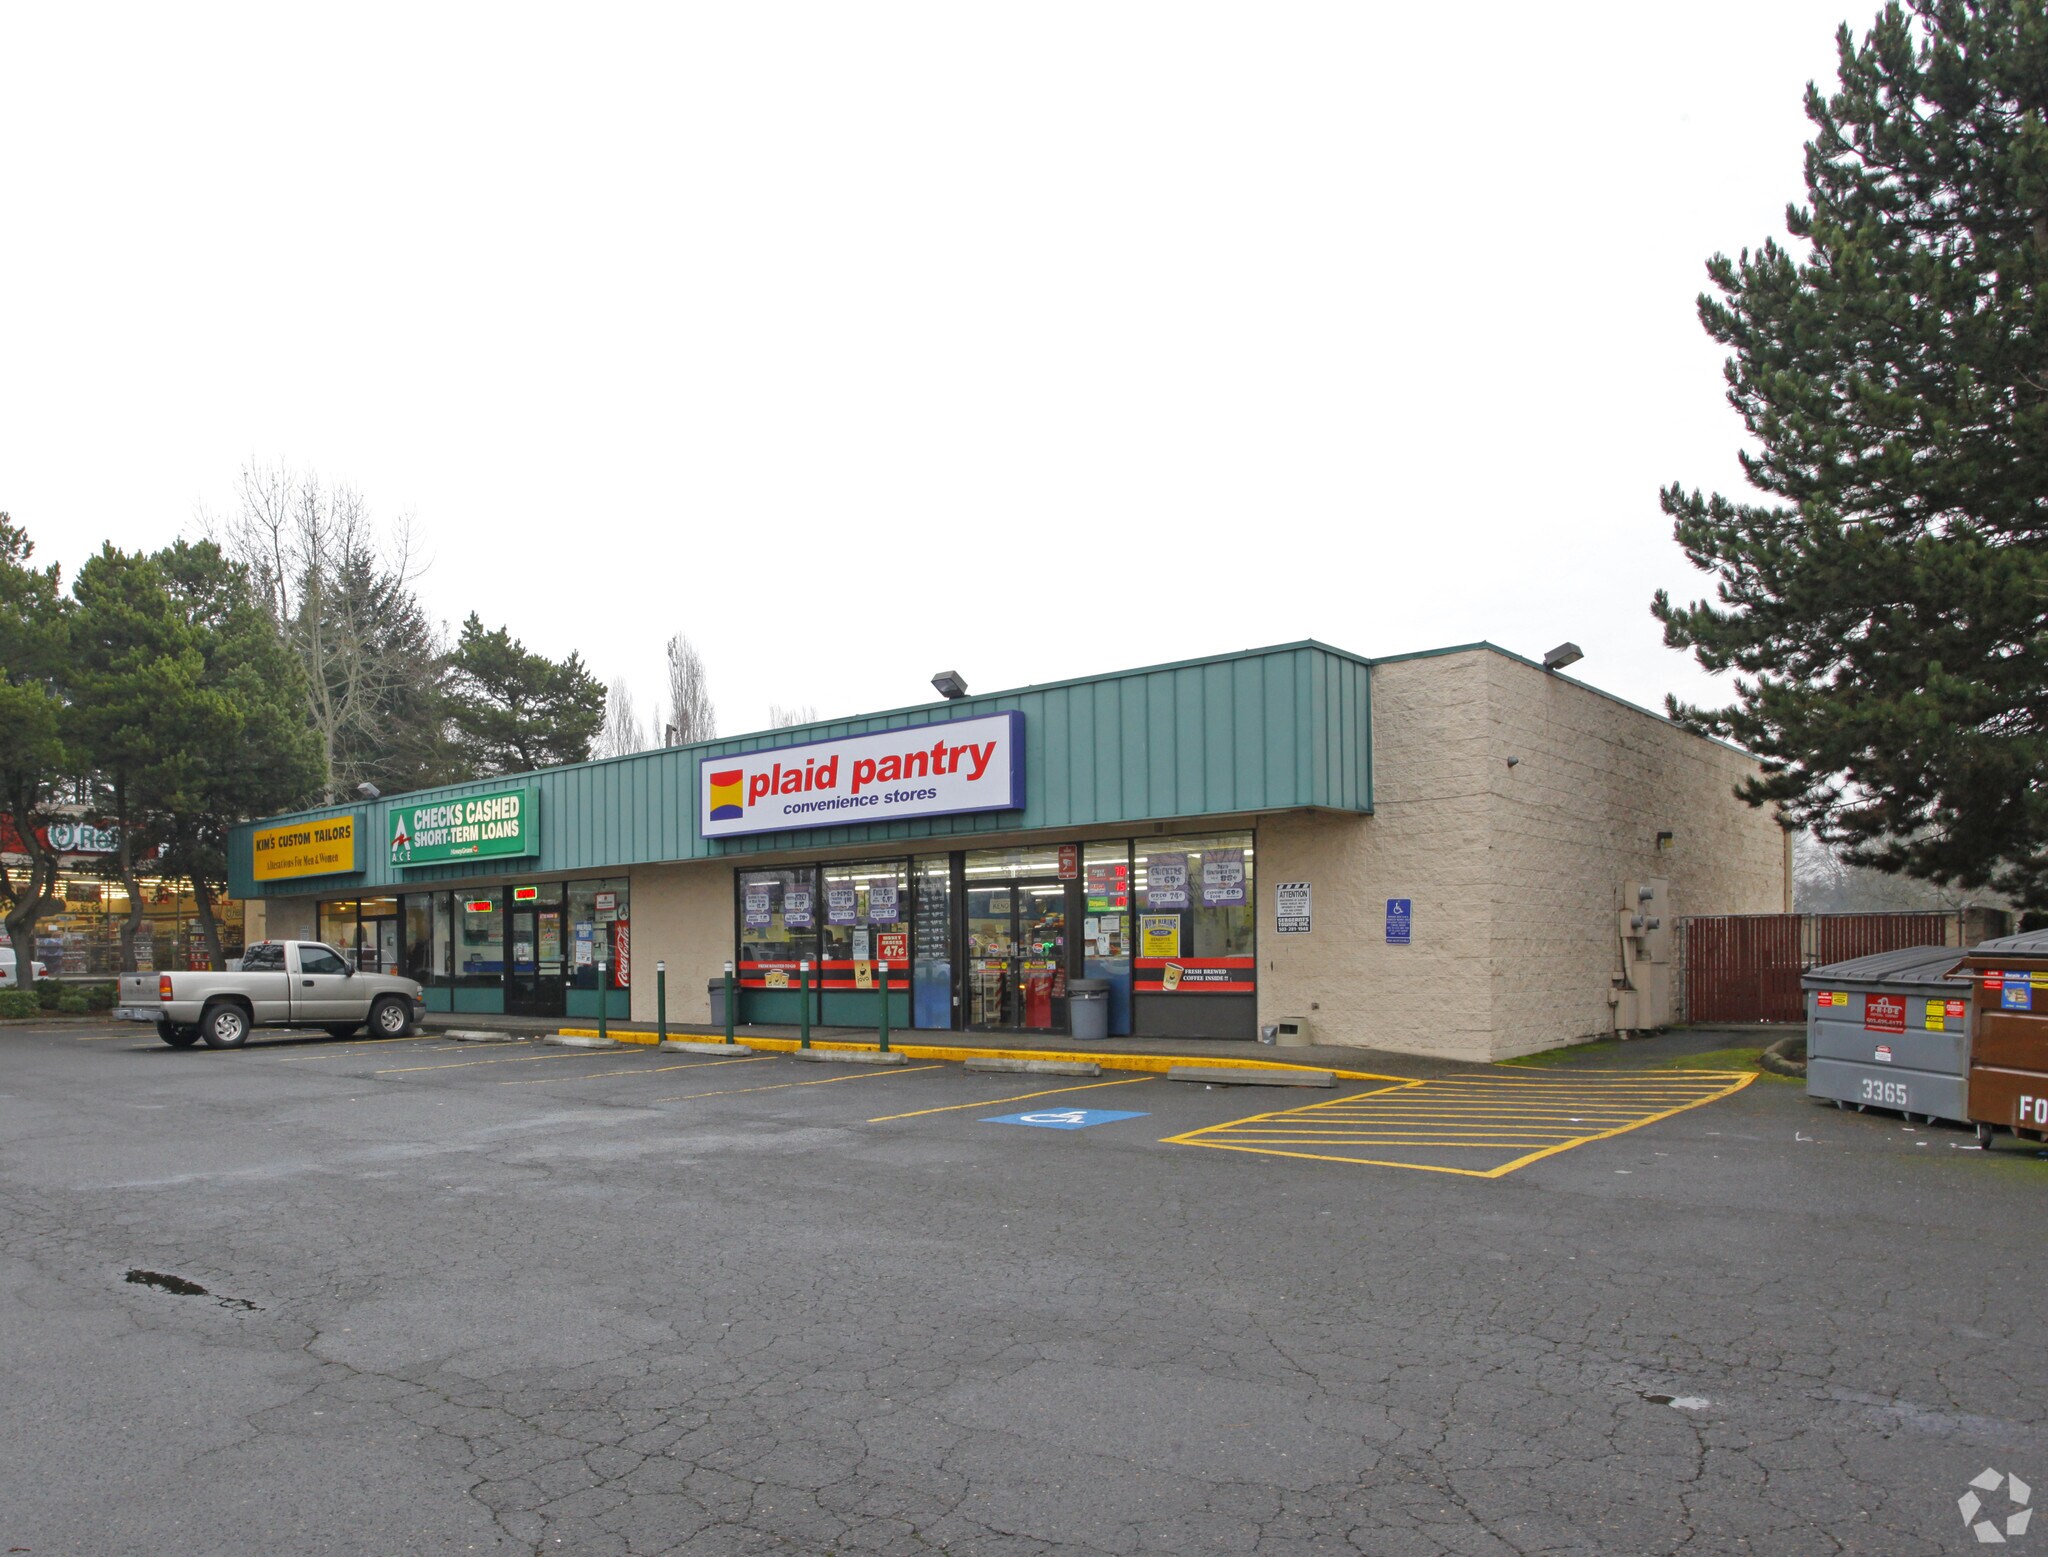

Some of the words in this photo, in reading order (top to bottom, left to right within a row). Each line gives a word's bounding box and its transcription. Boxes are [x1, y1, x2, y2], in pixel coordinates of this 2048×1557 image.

[747, 754, 840, 807] plaid
[851, 739, 998, 795] pantry
[413, 804, 464, 830] CHECKS
[466, 796, 520, 824] CASHED
[783, 793, 880, 815] convenience
[884, 786, 938, 805] stores
[256, 833, 276, 852] KIM'S
[278, 831, 311, 848] CUSTOM
[314, 825, 351, 843] TAILORS
[413, 824, 479, 848] SHORT-TERM
[482, 819, 520, 840] LOANS
[391, 850, 411, 862] ACE
[1279, 890, 1308, 898] ATTENTION
[883, 945, 905, 957] 47¢
[1862, 1078, 1907, 1105] 3365
